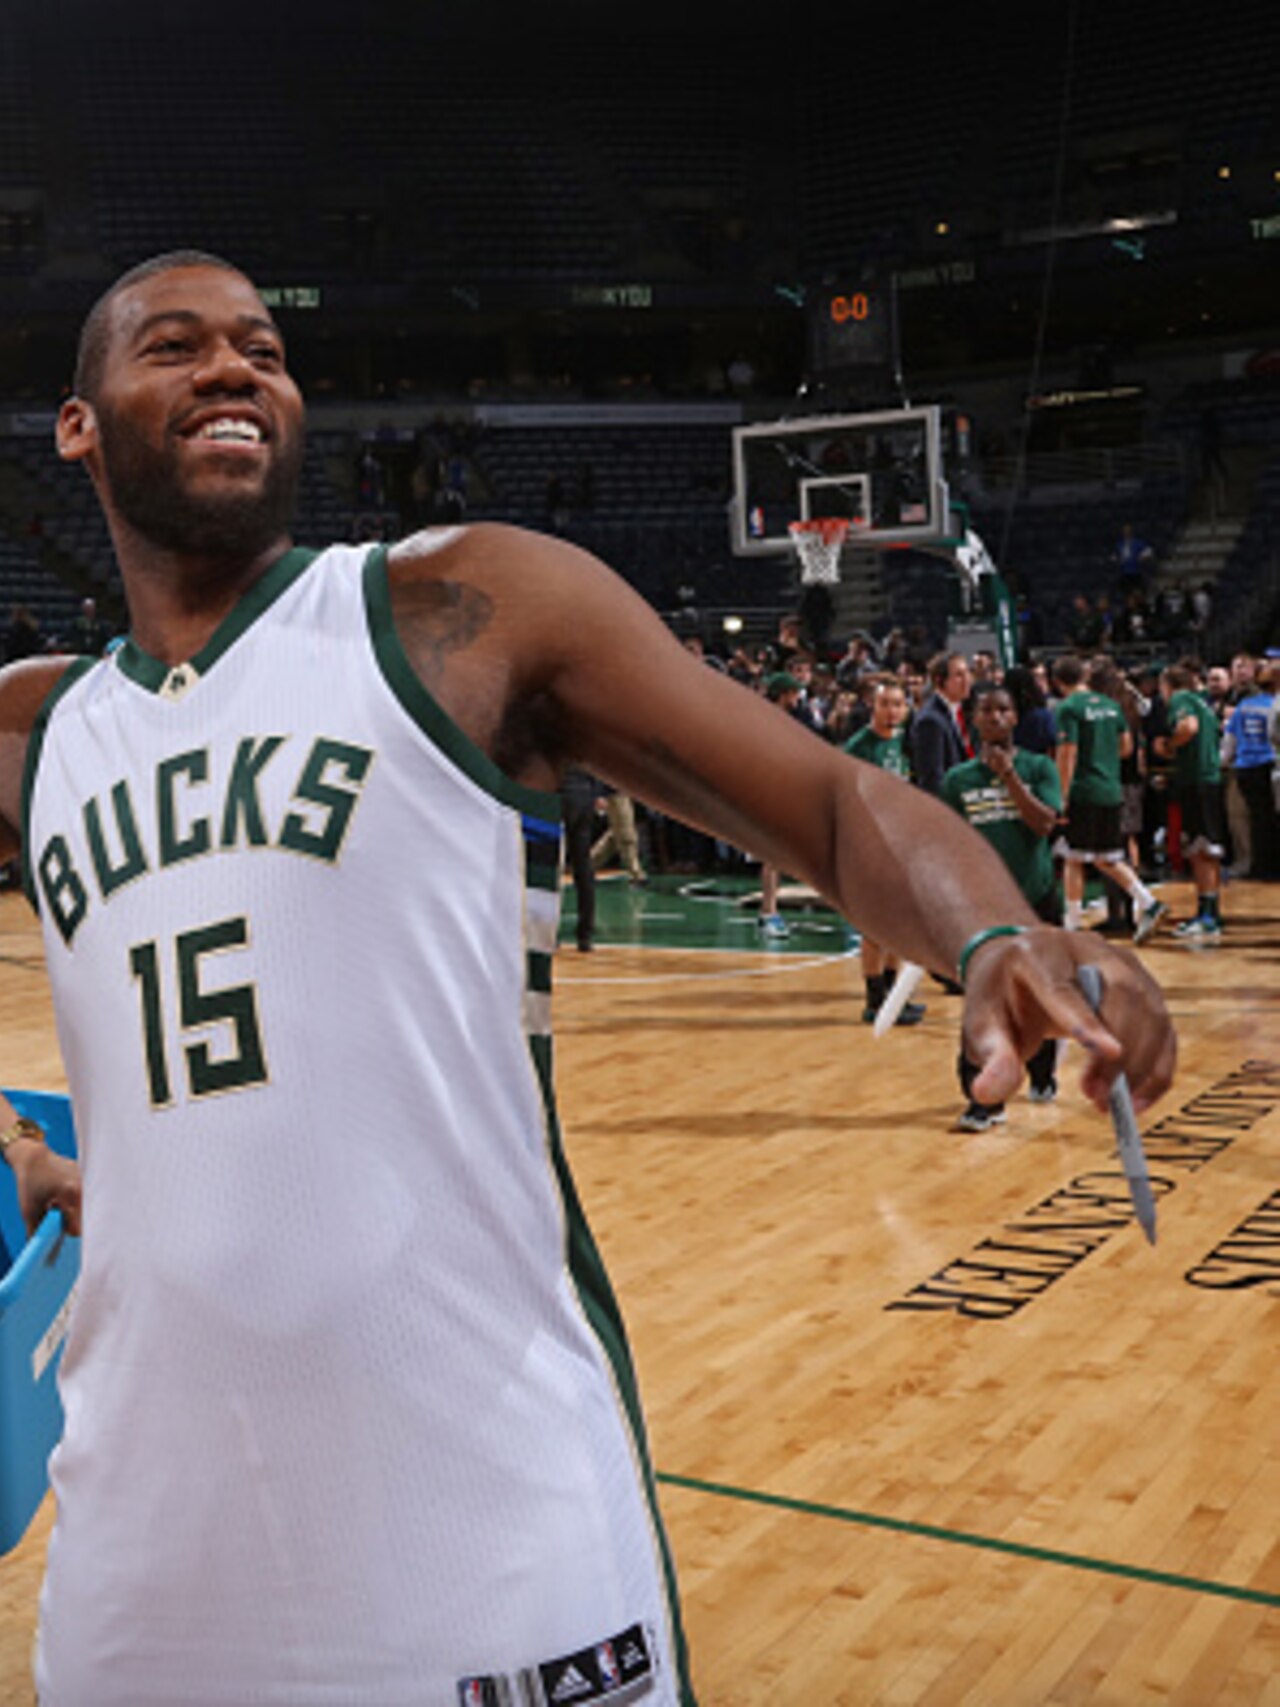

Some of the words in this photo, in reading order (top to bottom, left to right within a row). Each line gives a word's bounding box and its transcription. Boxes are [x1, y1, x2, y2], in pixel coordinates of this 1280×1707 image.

[282, 287, 320, 309] YOU
[619, 284, 653, 308] YOU
[37, 736, 375, 951] BUCKS
[129, 916, 269, 1111] 15
[883, 1171, 1177, 1320] CENTER
